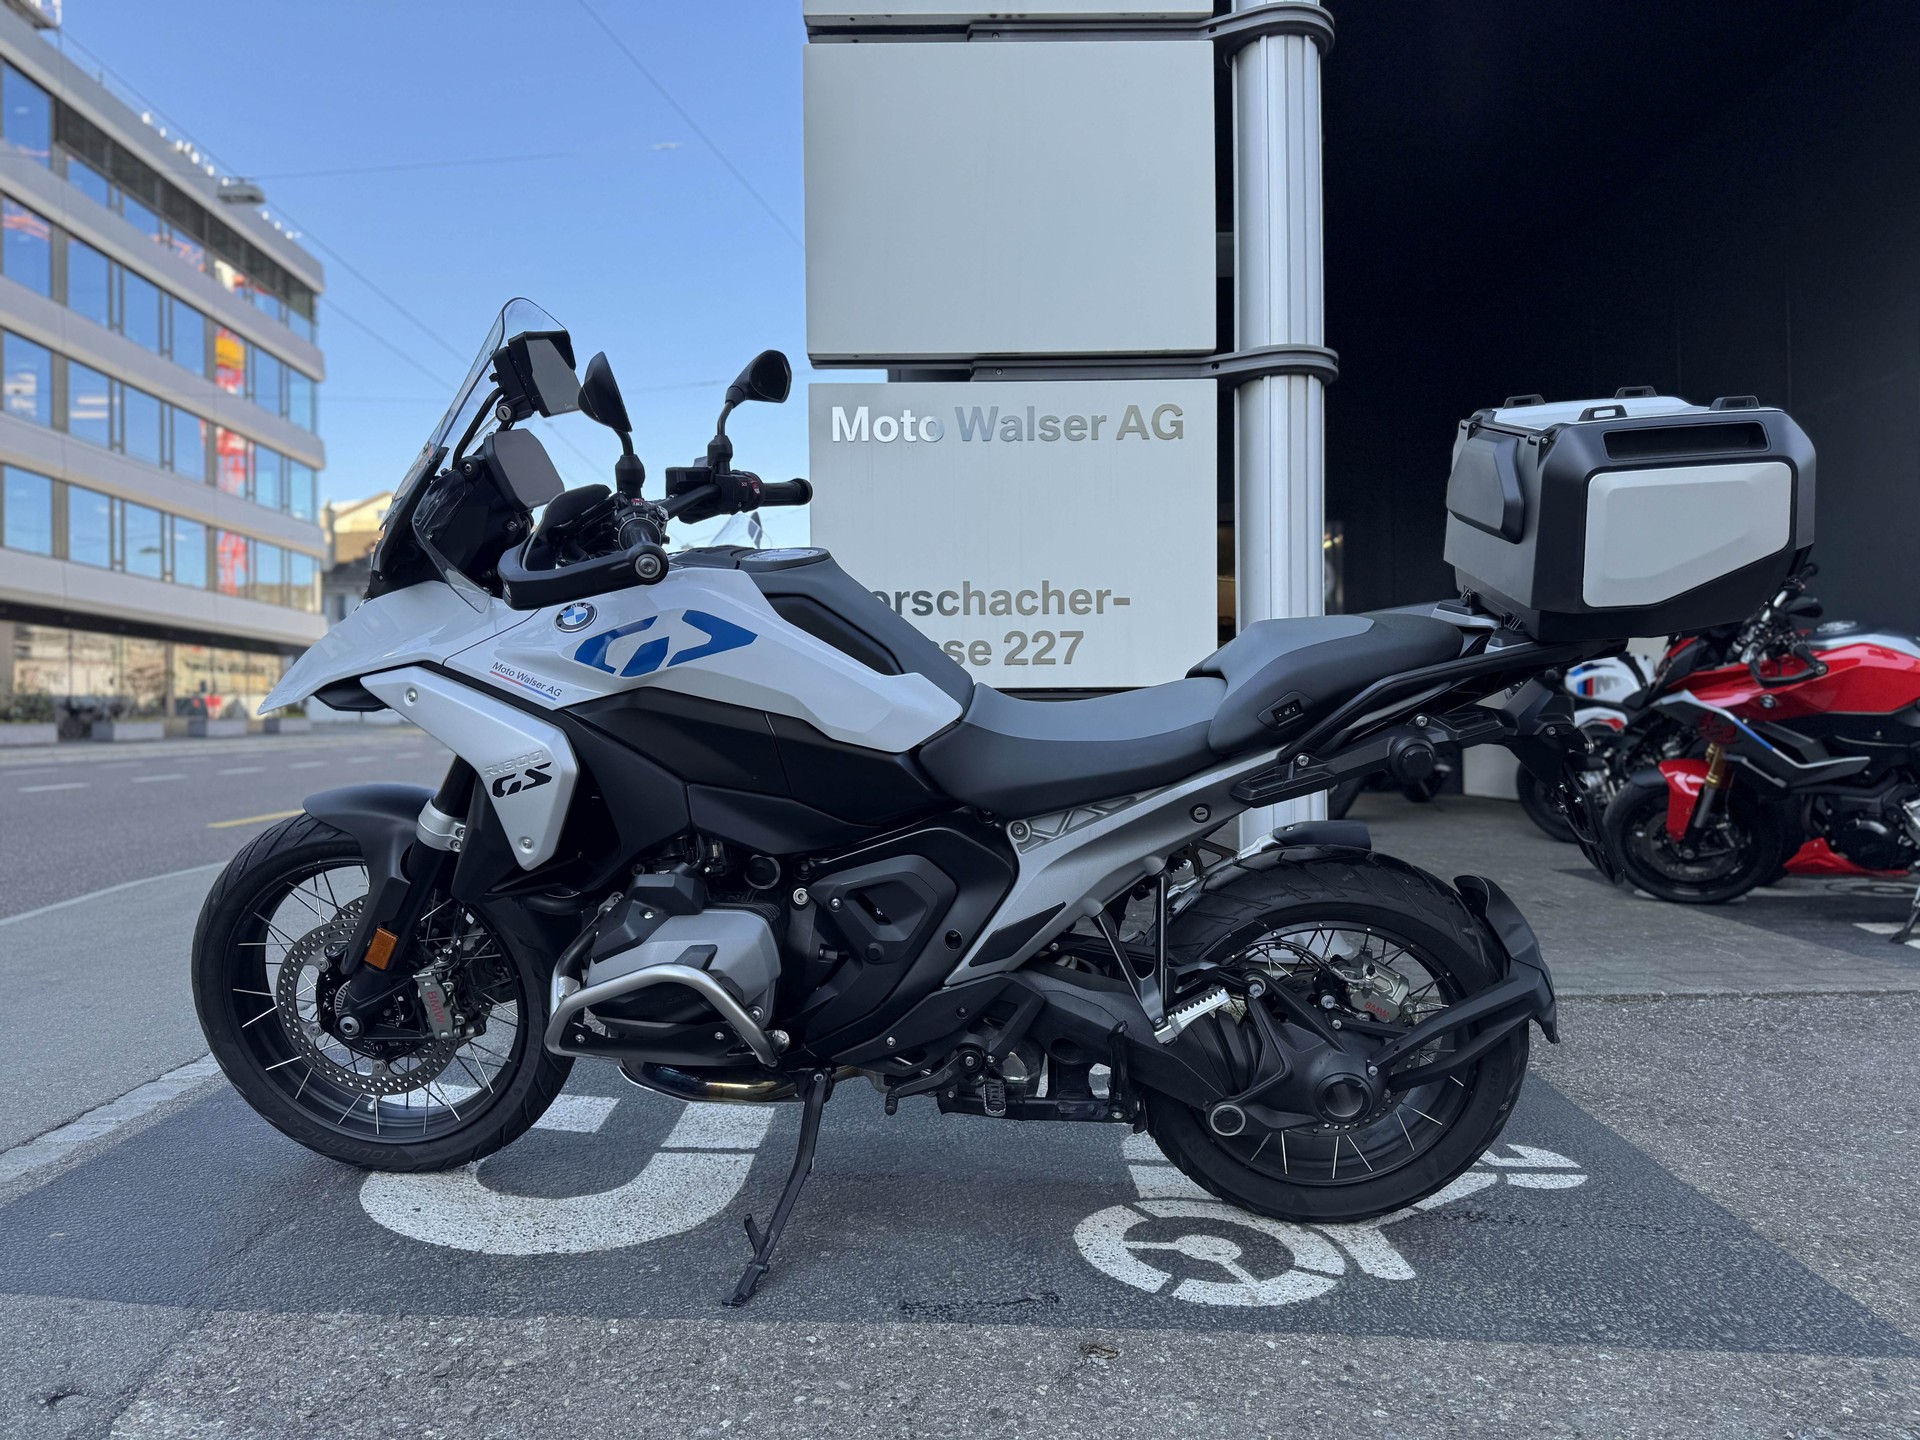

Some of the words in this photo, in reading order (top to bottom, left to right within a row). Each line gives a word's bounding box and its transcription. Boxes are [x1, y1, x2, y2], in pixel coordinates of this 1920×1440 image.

[831, 405, 945, 444] Moto
[955, 405, 1108, 442] Walser
[1115, 403, 1185, 441] AG
[1003, 630, 1085, 666] 227
[492, 661, 515, 677] Moto
[516, 671, 548, 690] Walser
[546, 685, 563, 697] AG
[492, 762, 552, 798] GS
[426, 990, 446, 1025] BMW
[1364, 1002, 1390, 1018] BMW
